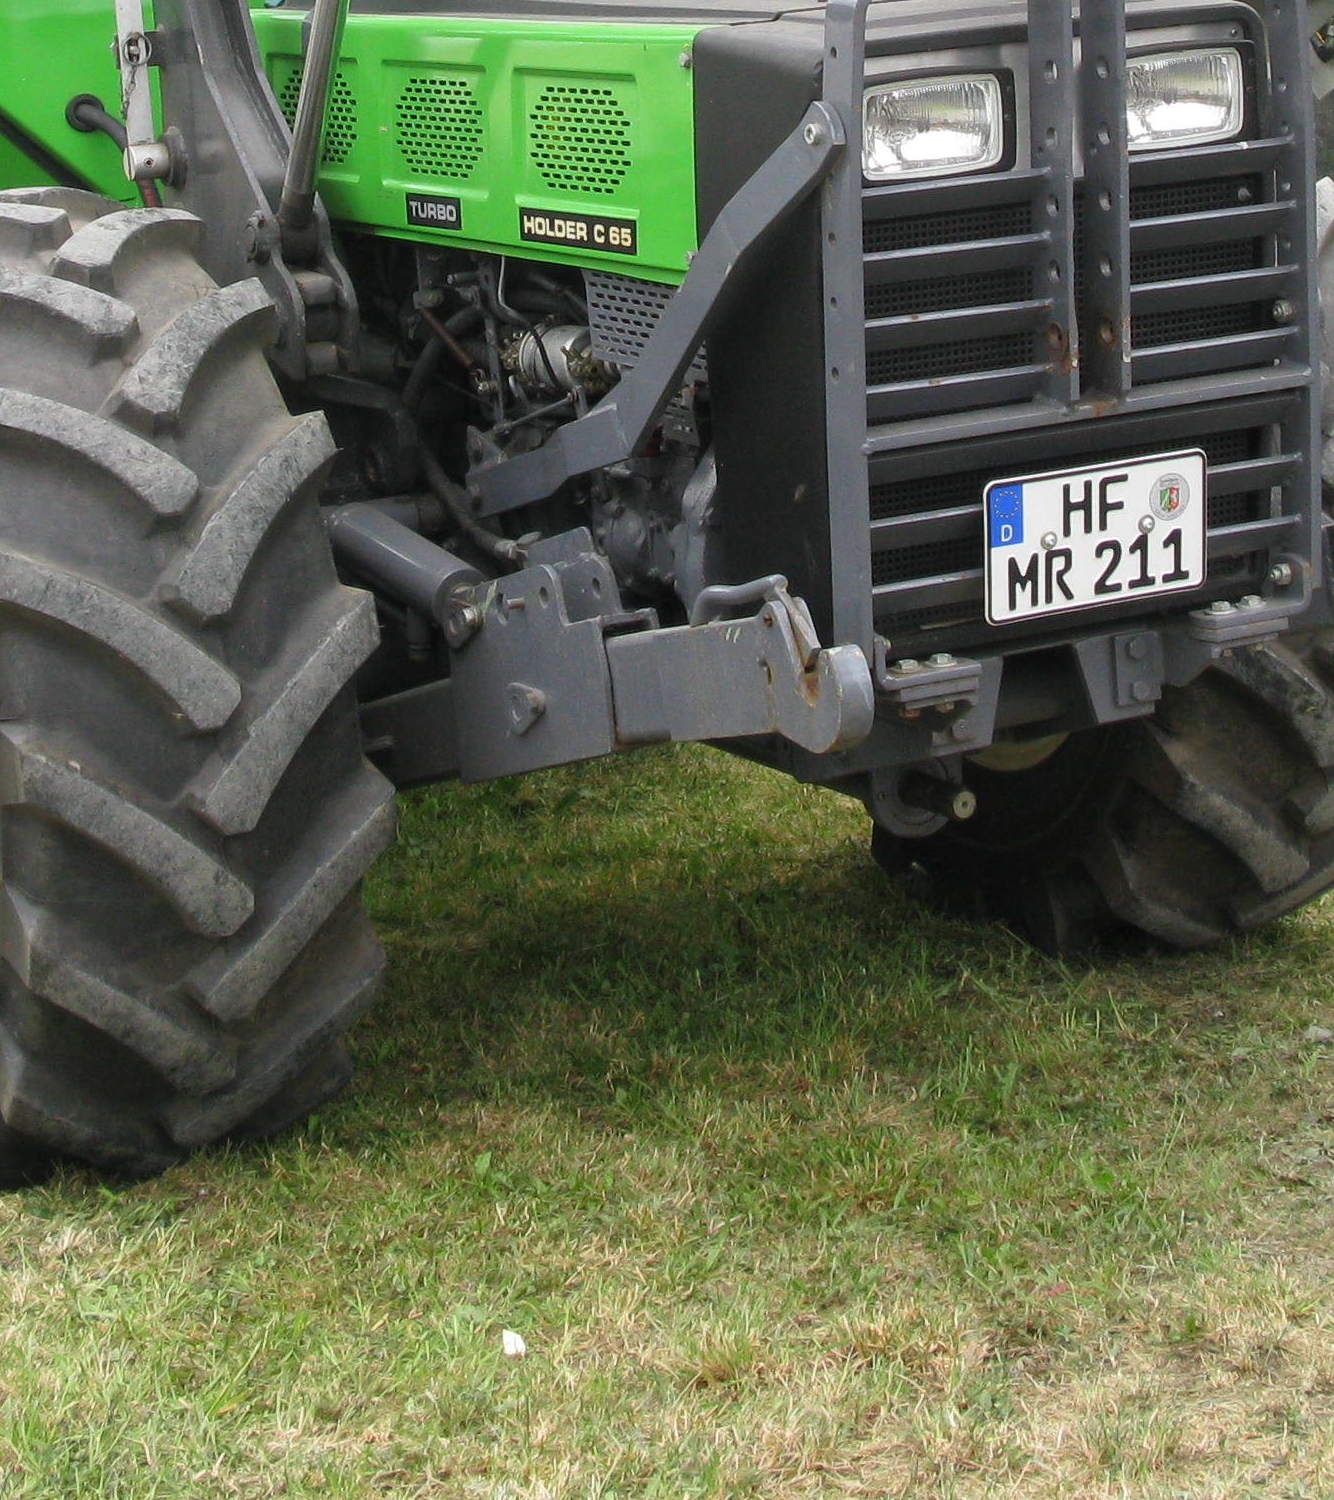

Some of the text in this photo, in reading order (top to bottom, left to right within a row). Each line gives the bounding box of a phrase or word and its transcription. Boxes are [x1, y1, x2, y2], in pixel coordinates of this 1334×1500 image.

[409, 200, 457, 222] TURBO
[523, 215, 632, 247] HOLDER C 65
[1063, 473, 1129, 538] HF
[1000, 524, 1013, 542] D
[1008, 528, 1190, 611] MR 211
